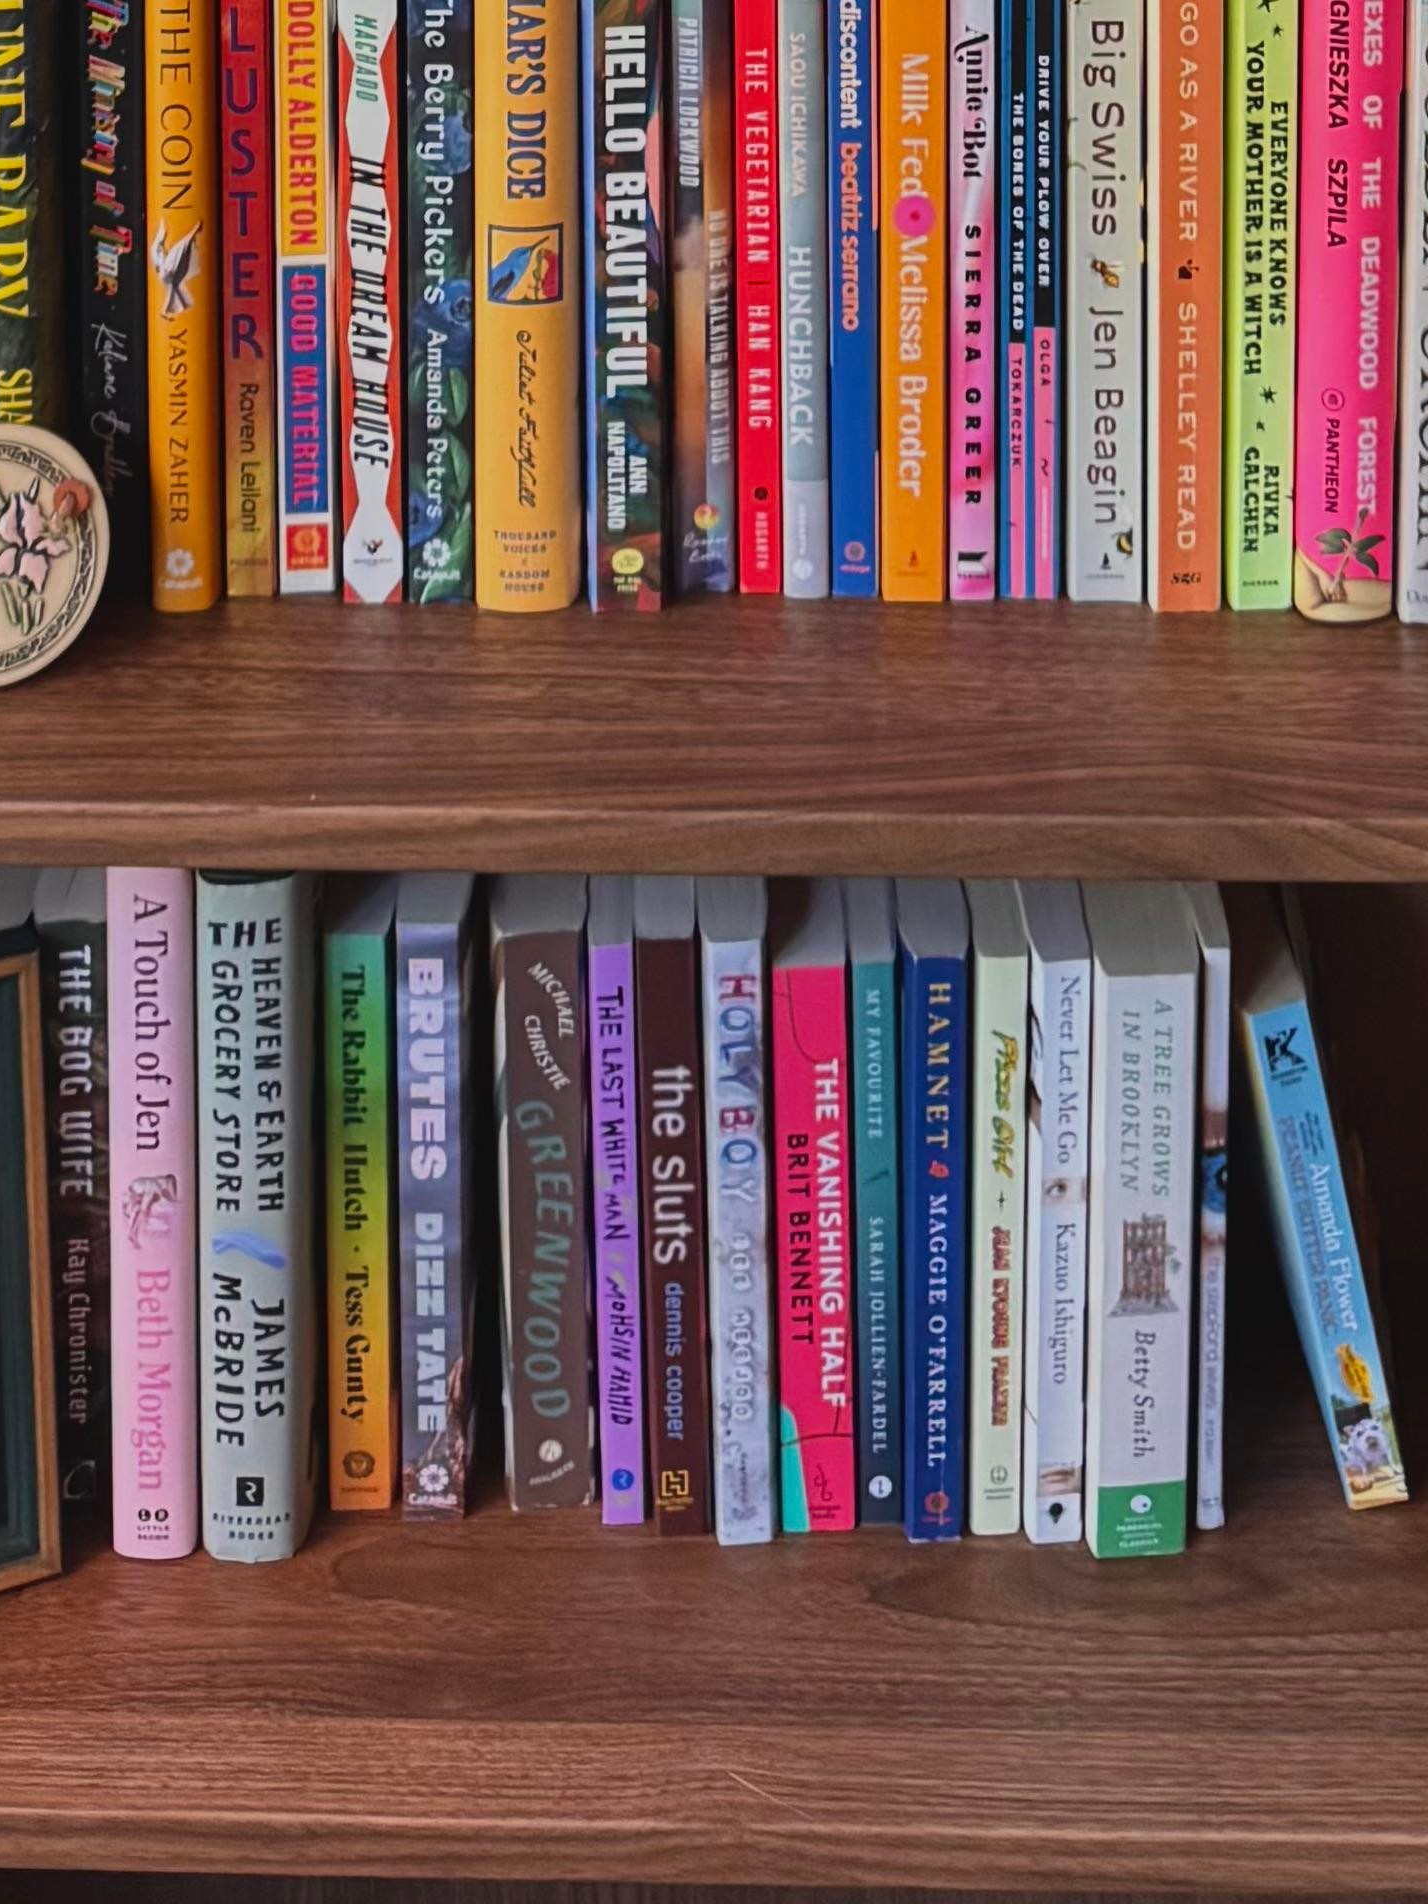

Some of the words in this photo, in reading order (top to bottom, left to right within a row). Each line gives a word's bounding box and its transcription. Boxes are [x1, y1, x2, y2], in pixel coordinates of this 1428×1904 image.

[160, 0, 192, 84] THE
[1090, 19, 1127, 88] Big
[604, 25, 646, 158] HELLO
[160, 101, 192, 211] COIN
[1090, 102, 1126, 237] Swiss
[604, 170, 650, 398] BEAUTIFUL
[1089, 305, 1118, 371] Jen
[1087, 386, 1128, 524] Beagin
[134, 893, 166, 924] A
[135, 930, 171, 1043] Touch
[136, 1048, 171, 1082] of
[652, 1064, 694, 1140] the
[814, 1058, 840, 1121] THE
[927, 982, 951, 1150] HAMNET
[136, 1091, 162, 1153] Jen
[652, 1157, 694, 1266] sluts
[816, 1132, 844, 1313] VANISHING
[136, 1268, 172, 1343] Beth
[822, 1323, 845, 1409] HALF
[1133, 1329, 1157, 1388] Betty
[130, 1352, 172, 1491] Morgan
[1133, 1398, 1156, 1458] Smith
